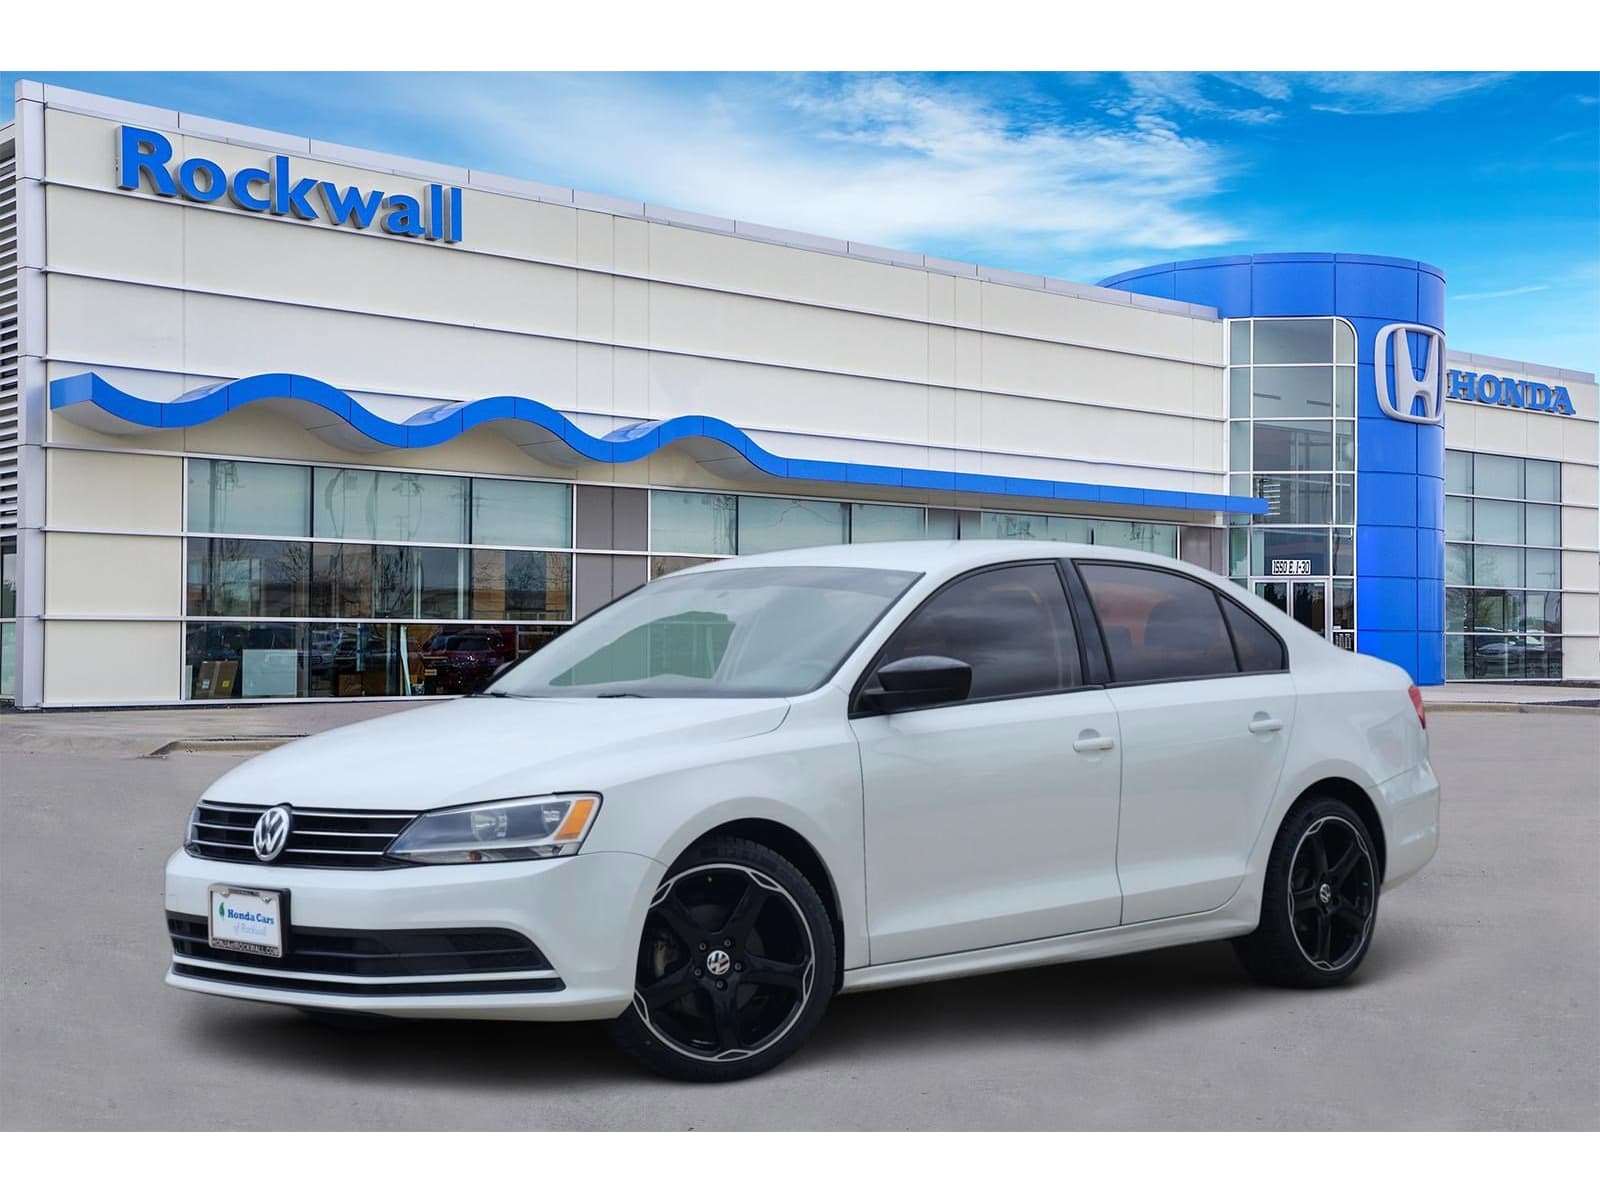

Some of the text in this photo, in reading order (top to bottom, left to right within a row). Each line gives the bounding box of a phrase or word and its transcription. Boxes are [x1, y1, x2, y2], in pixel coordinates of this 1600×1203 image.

[117, 124, 463, 243] Rockwall
[1448, 369, 1576, 415] HONDA
[227, 908, 275, 925] Honda Cars
